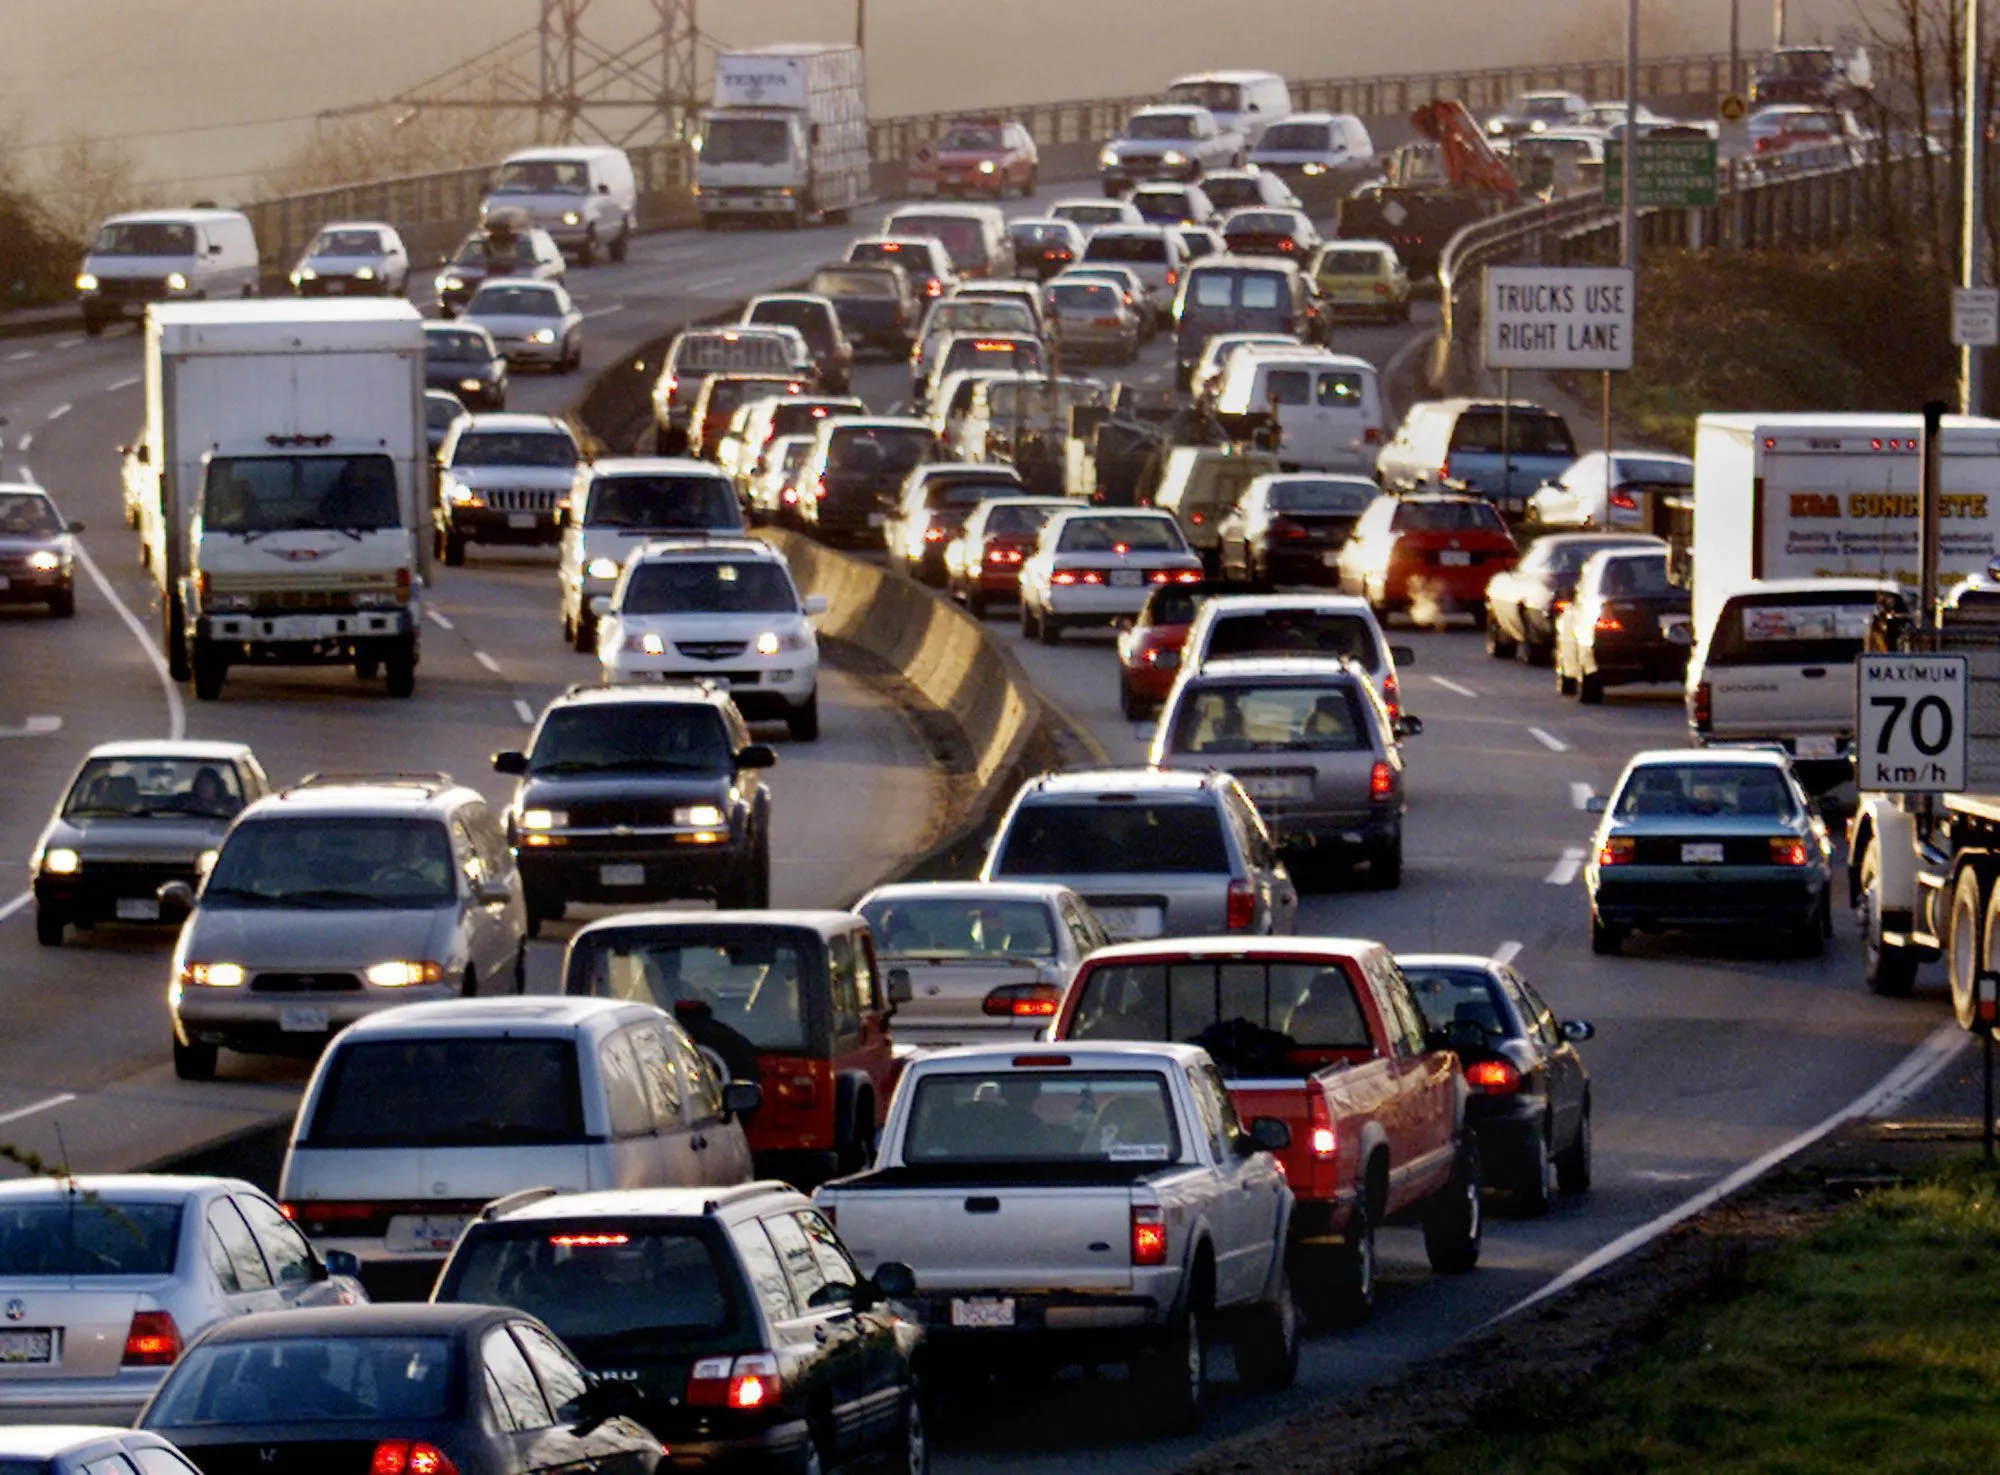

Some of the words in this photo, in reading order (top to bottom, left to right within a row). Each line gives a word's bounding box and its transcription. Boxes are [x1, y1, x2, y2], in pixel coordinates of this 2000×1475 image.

[1497, 284, 1574, 313] TRUCKS
[1586, 284, 1625, 313] USE
[1499, 323, 1556, 350] RIGHT
[1568, 323, 1620, 351] LANE
[1848, 493, 1988, 518] CONCETE
[1868, 666, 1957, 682] MAXIMUM
[1870, 695, 1953, 756] 70
[1876, 763, 1947, 782] km/h
